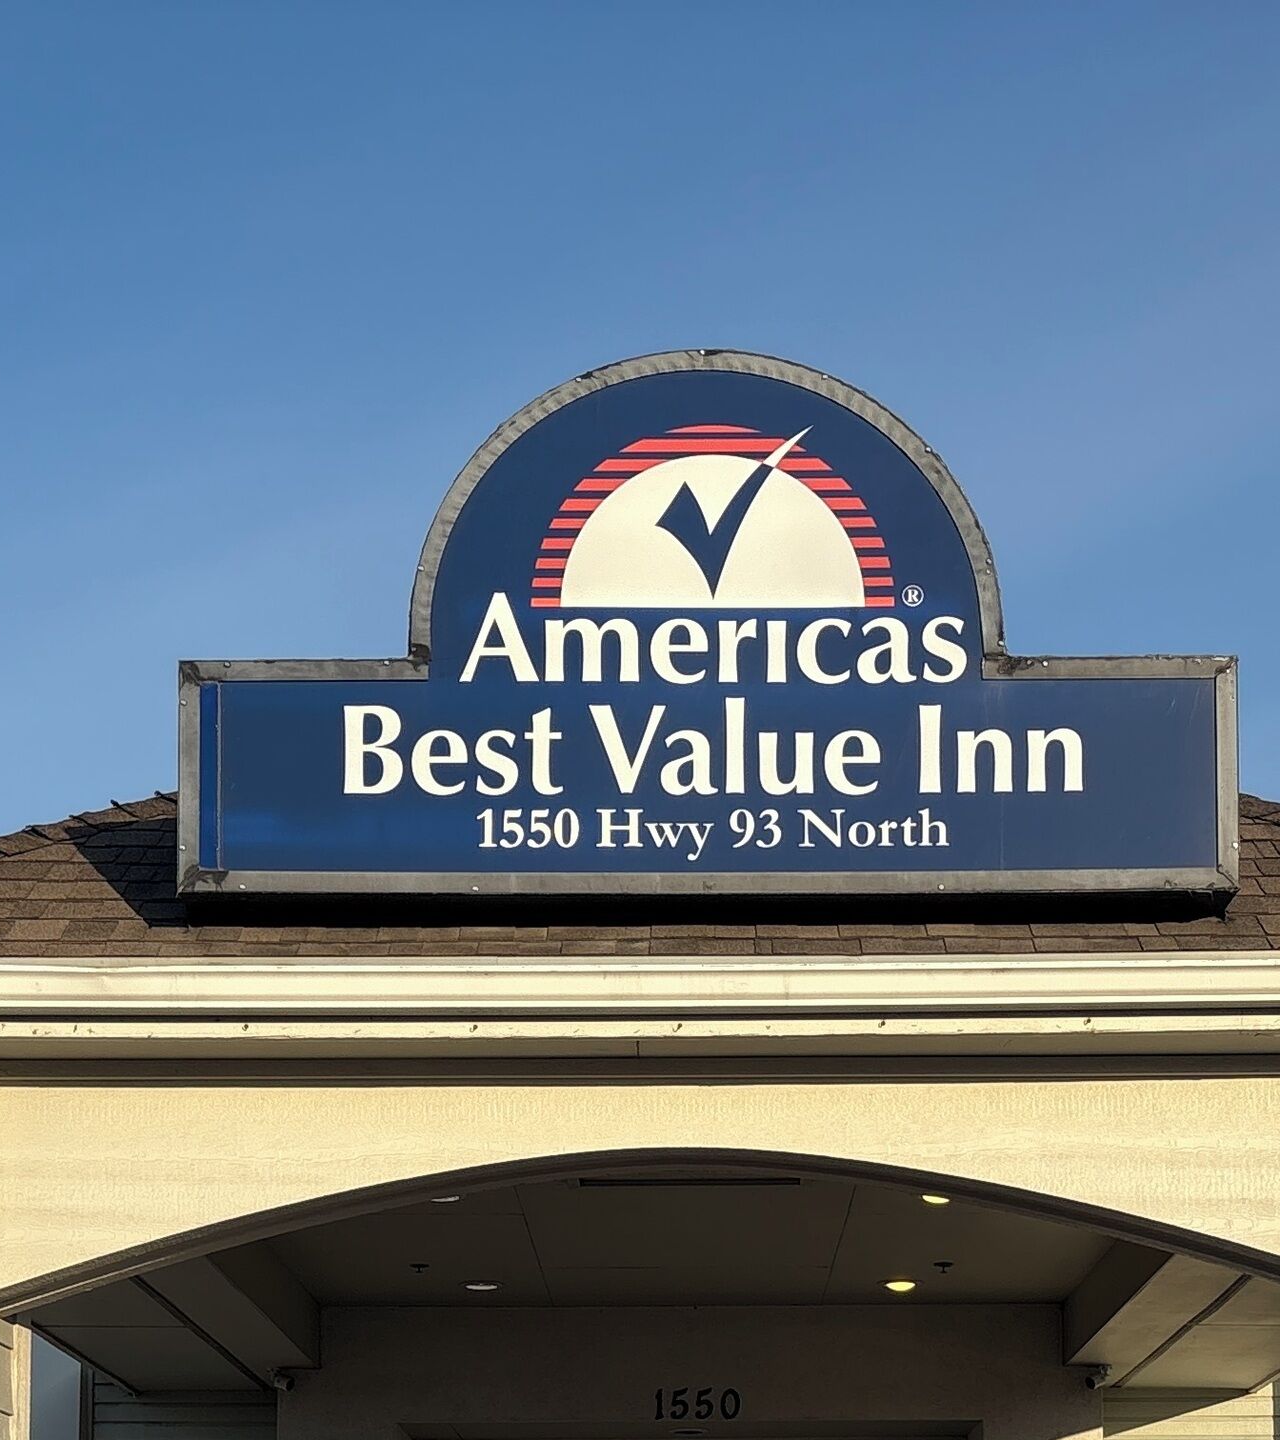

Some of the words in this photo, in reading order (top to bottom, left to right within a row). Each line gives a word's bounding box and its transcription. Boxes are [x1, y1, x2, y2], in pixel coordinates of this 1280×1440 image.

[458, 592, 969, 685] Americas
[343, 704, 564, 796] Best
[588, 696, 881, 796] Value
[918, 704, 1084, 794] Inn
[476, 808, 580, 849] 1550
[596, 808, 715, 861] Hwy
[729, 808, 782, 849] 93
[797, 807, 950, 848] North
[654, 1387, 741, 1420] 1550
